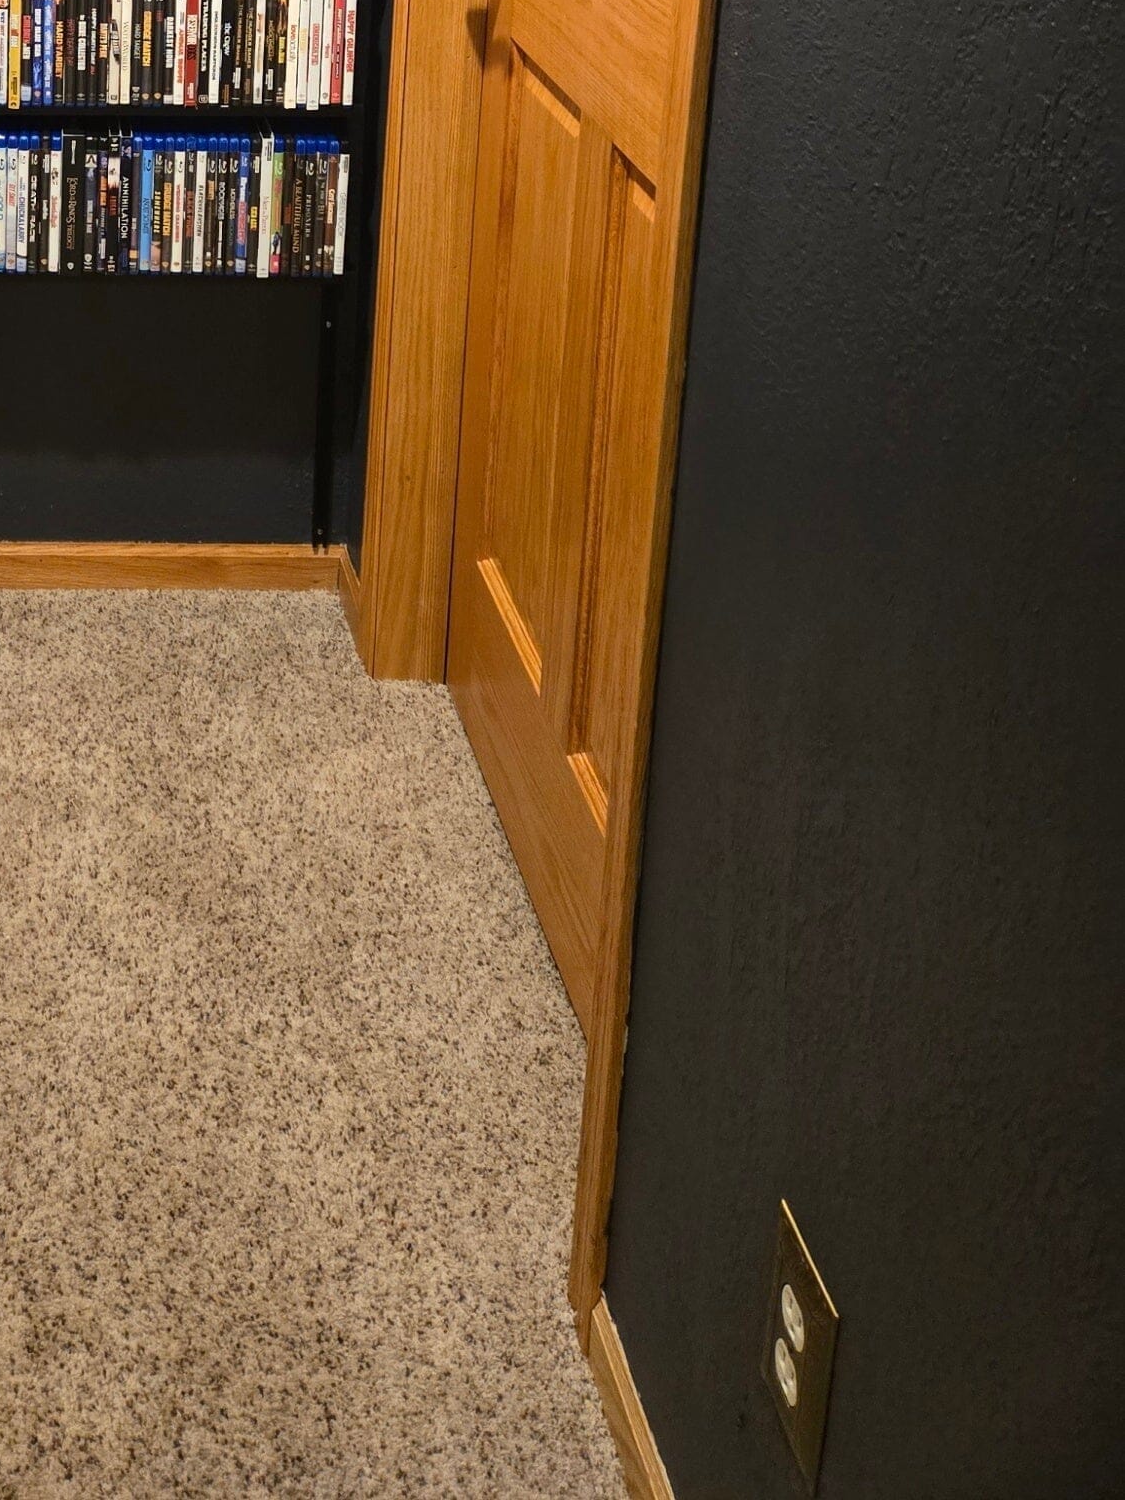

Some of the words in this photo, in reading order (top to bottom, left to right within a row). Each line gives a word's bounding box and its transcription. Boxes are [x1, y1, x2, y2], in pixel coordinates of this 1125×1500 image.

[56, 21, 64, 45] HARD
[55, 46, 63, 79] TARGET
[120, 177, 129, 239] ANNIHILATION
[294, 186, 302, 228] BEAUTIFUL
[292, 228, 301, 253] MIND
